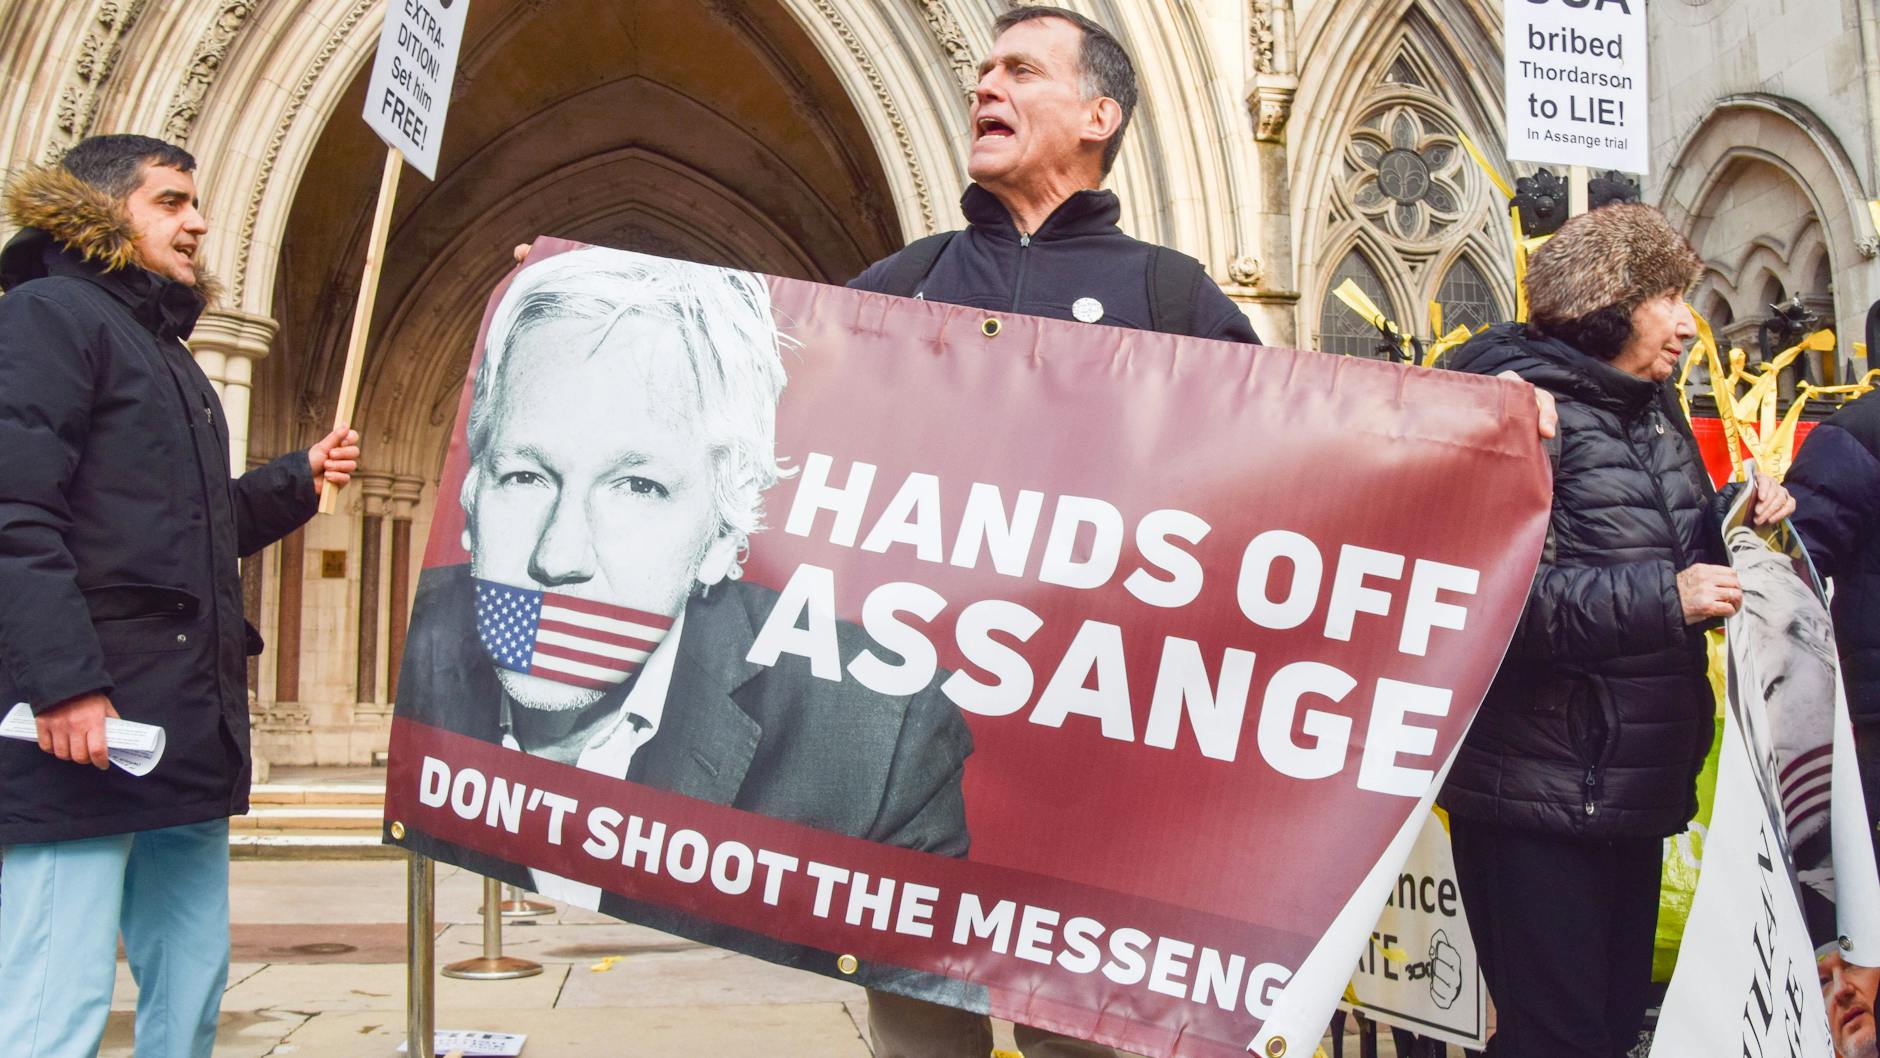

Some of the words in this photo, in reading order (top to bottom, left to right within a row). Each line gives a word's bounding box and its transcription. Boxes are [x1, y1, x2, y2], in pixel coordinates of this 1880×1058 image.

[404, 0, 445, 48] EXTRA-
[1528, 23, 1623, 60] bribed
[397, 23, 440, 83] DITION!
[1519, 60, 1633, 90] Thordarson
[391, 56, 412, 91] Set
[413, 76, 432, 113] him
[1528, 92, 1558, 120] to
[1570, 95, 1625, 127] LIE!
[381, 87, 428, 151] FREE!
[1527, 128, 1540, 140] In
[1544, 129, 1601, 148] Assange
[1605, 136, 1628, 150] trial
[785, 451, 1213, 608] HANDS
[1236, 528, 1481, 657] OFF
[745, 562, 1453, 798] ASSANGE
[419, 755, 578, 846] DON'T
[582, 806, 799, 906] SHOOT
[806, 860, 940, 938] THE
[952, 892, 1295, 1022] MESSENG
[1386, 871, 1457, 917] nce
[1358, 931, 1399, 982] TE
